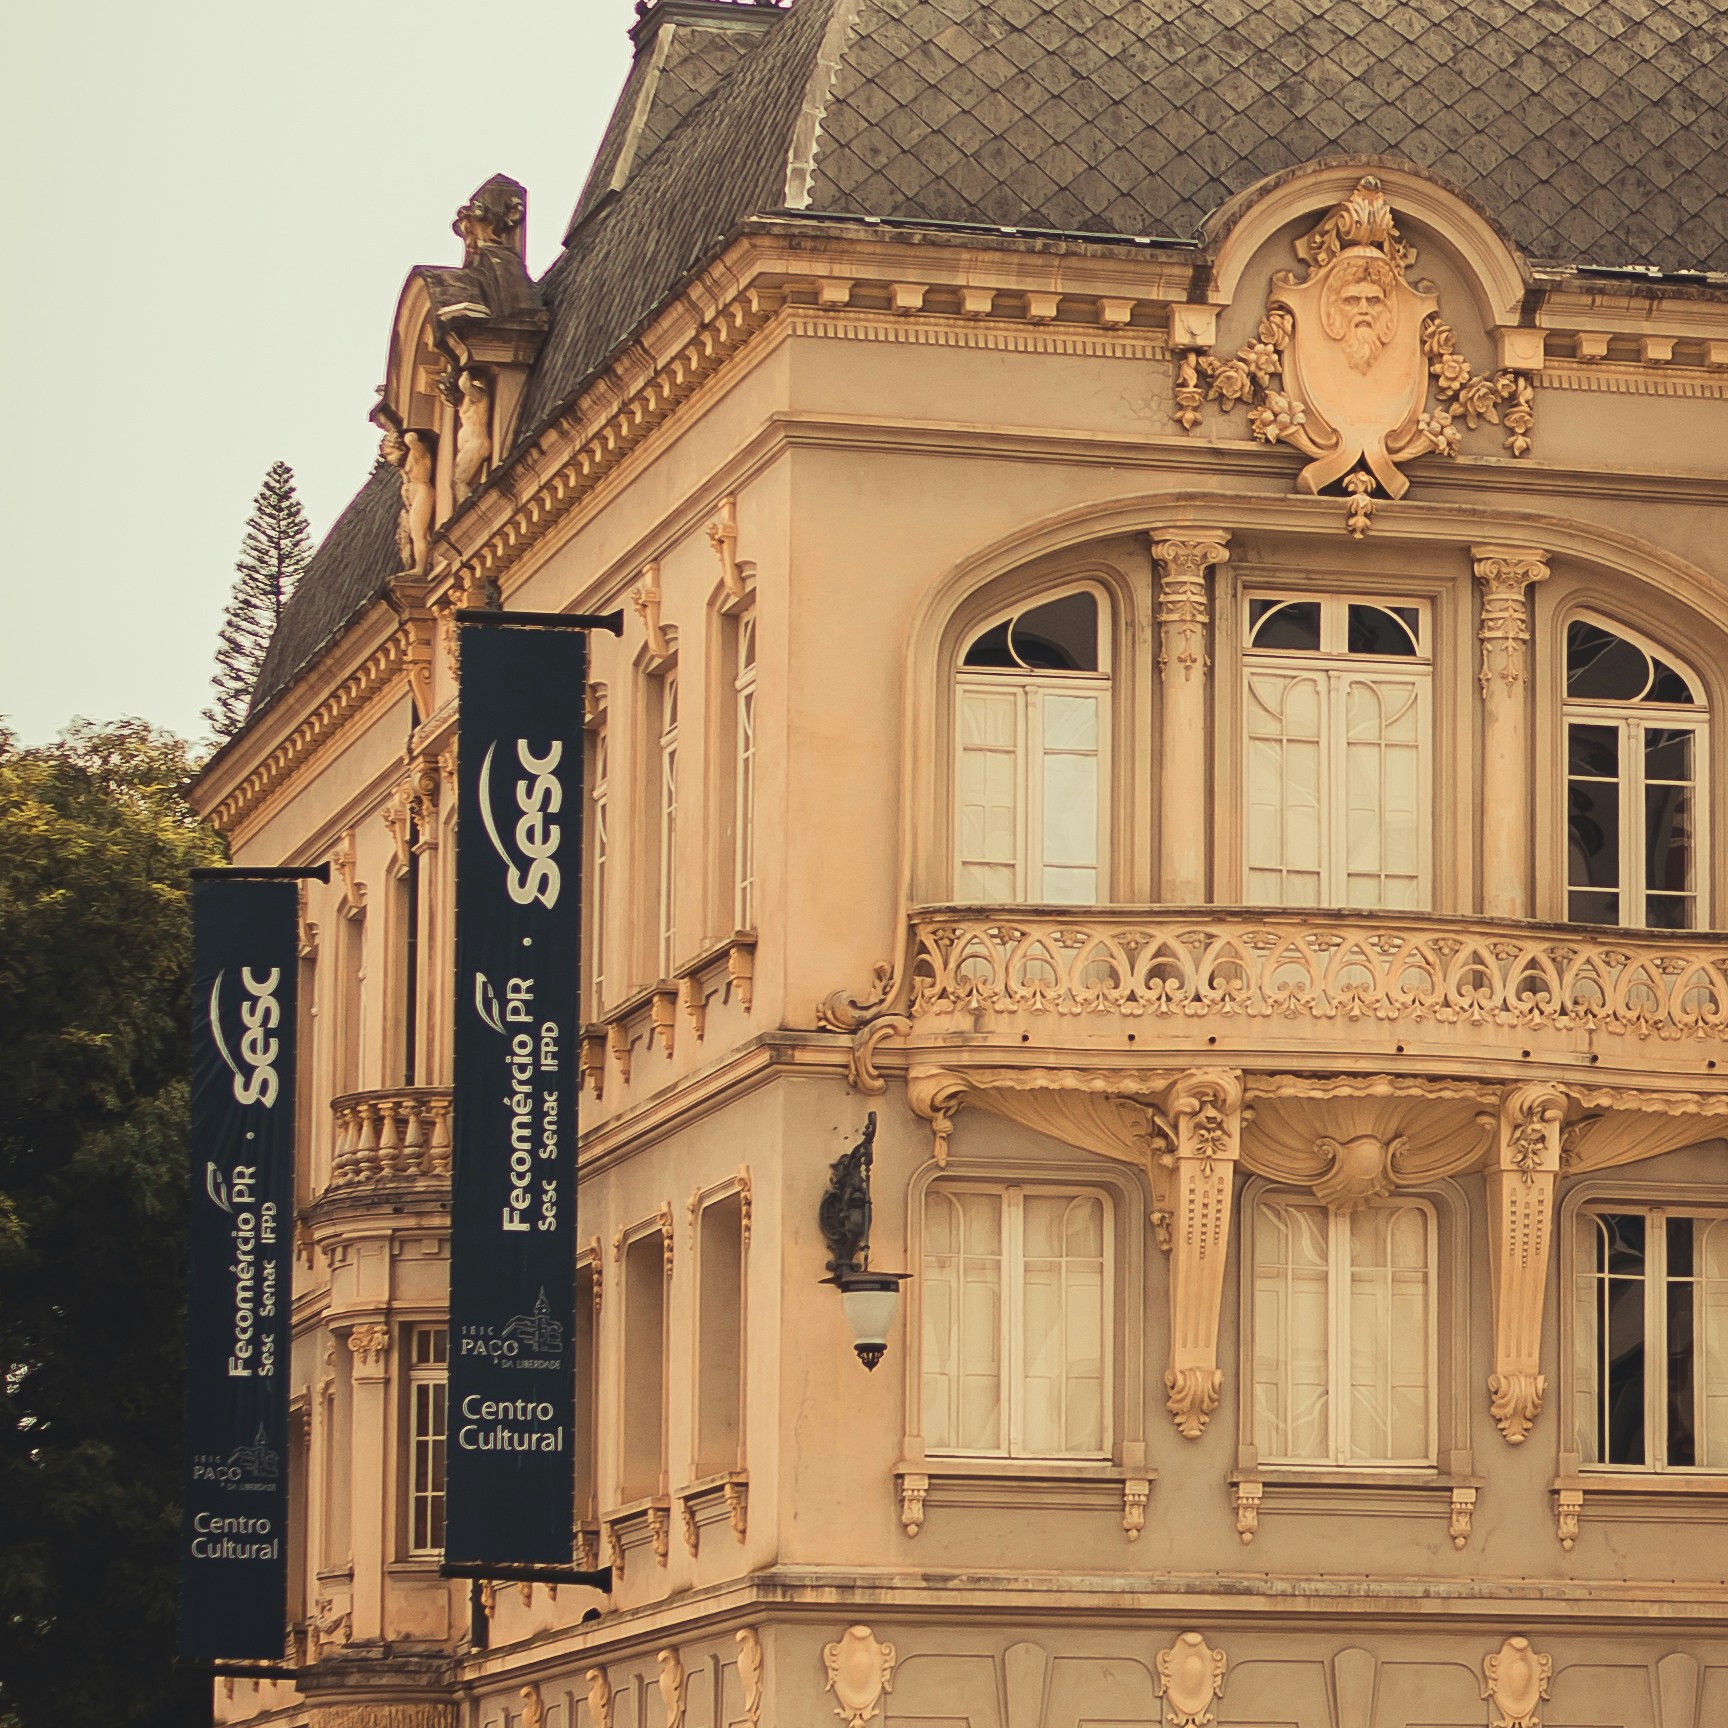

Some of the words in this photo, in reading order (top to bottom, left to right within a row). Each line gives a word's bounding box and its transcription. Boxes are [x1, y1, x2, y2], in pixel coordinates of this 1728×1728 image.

[506, 977, 534, 1022] PR
[540, 1021, 559, 1071] IFPD
[502, 1033, 534, 1231] Fecomércio
[539, 1091, 559, 1159] Senac
[232, 1165, 256, 1203] PR
[261, 1202, 277, 1244] IFPD
[538, 1180, 557, 1231] Sesc
[228, 1212, 255, 1377] Fecomércio
[259, 1259, 276, 1317] Senac
[258, 1333, 275, 1377] Sesc
[461, 1339, 519, 1364] PAÇO
[516, 1359, 561, 1370] LIBERDADE
[462, 1394, 554, 1421] Centro
[459, 1424, 563, 1452] Cultural
[193, 1466, 242, 1488] PAÇO
[194, 1512, 271, 1534] Centro
[191, 1537, 279, 1560] Cultural
